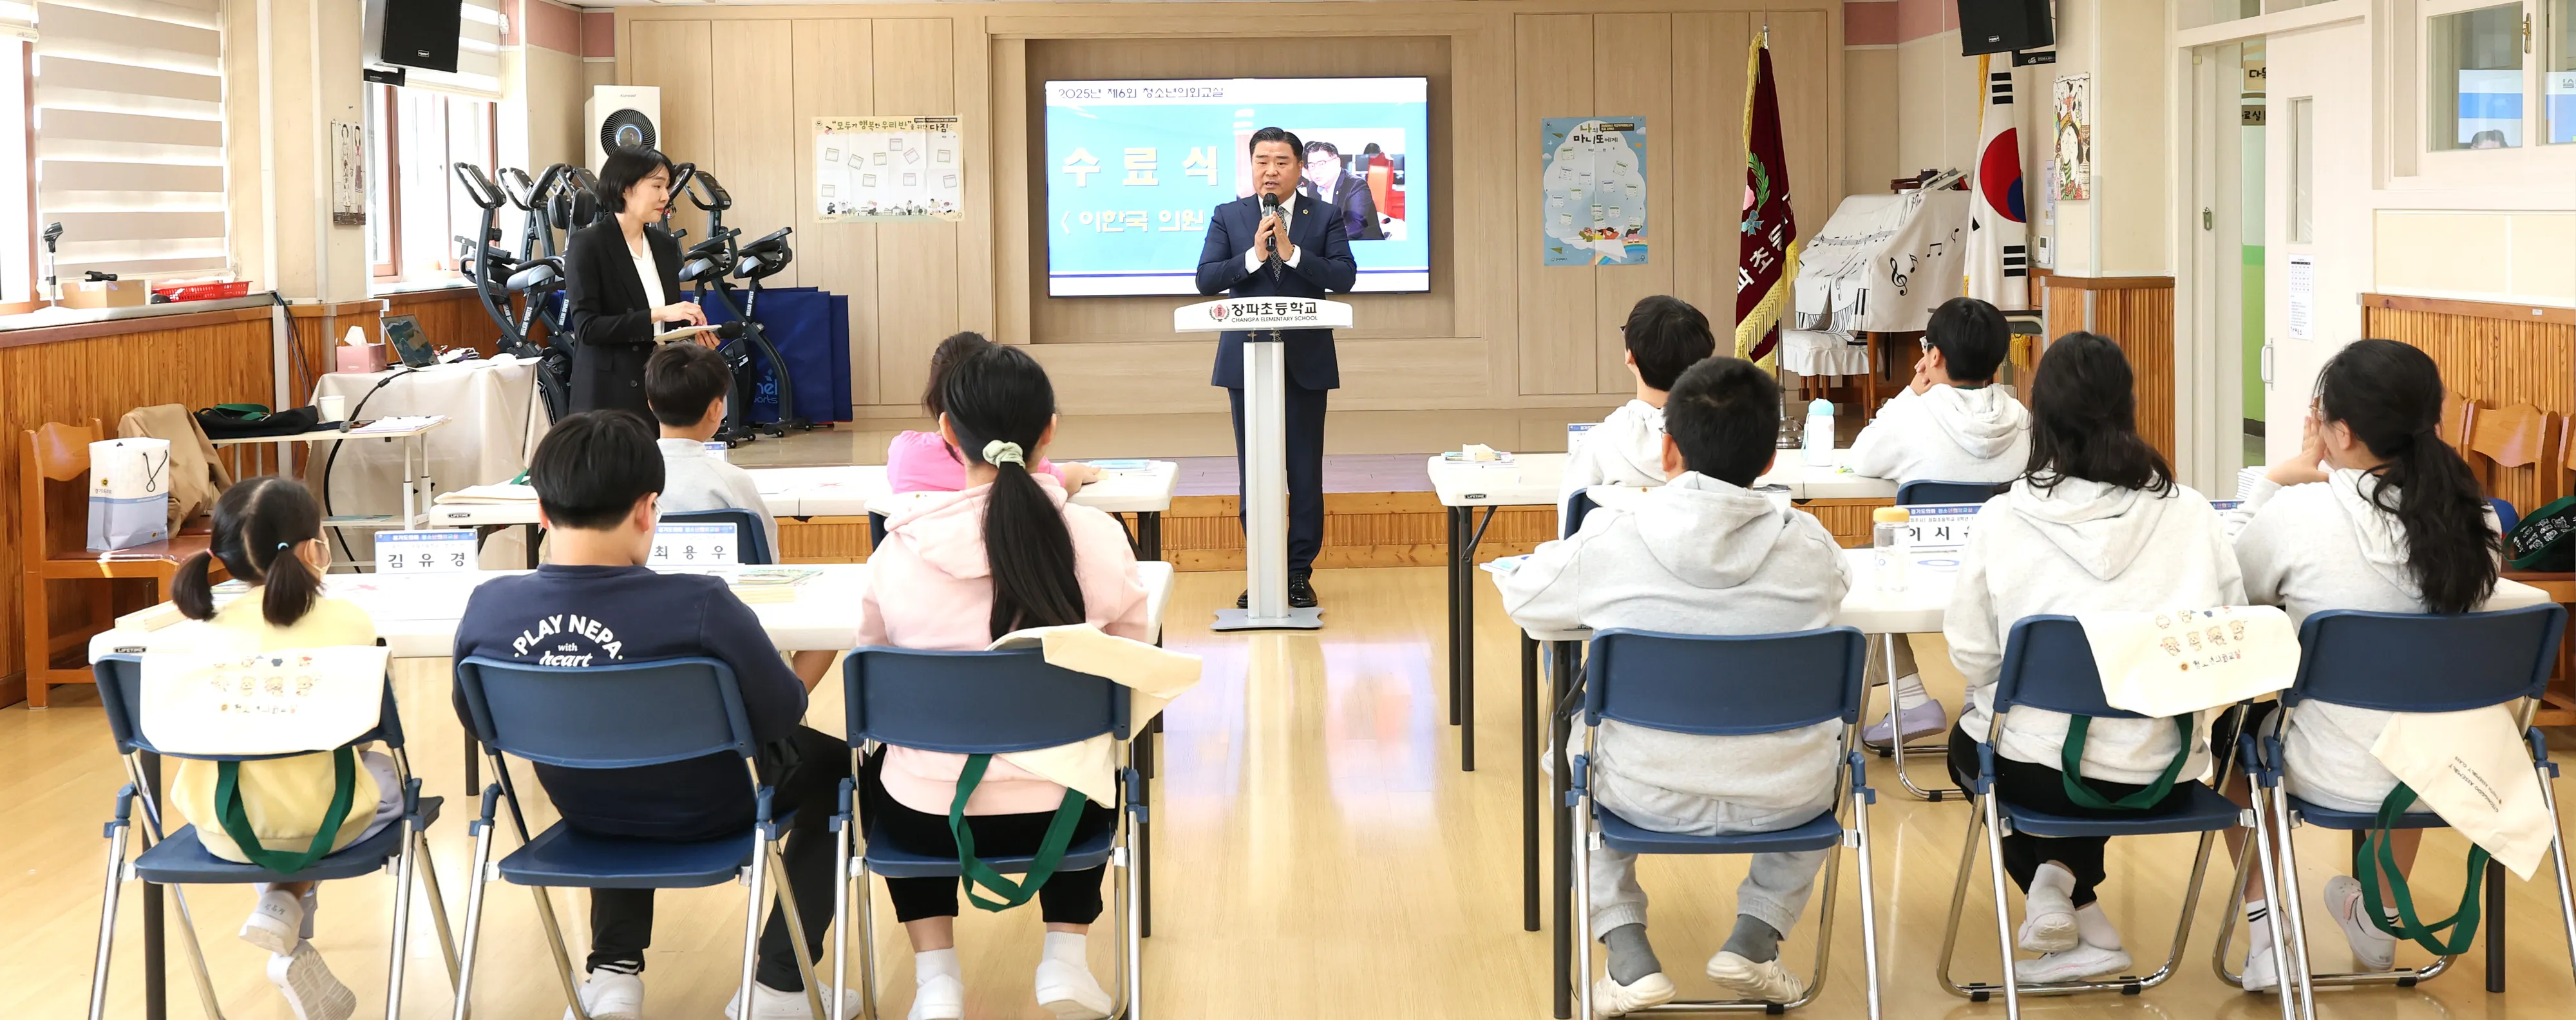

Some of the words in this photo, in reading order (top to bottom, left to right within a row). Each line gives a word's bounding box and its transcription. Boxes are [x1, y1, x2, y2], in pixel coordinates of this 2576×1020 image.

[1058, 88, 1101, 99] 2025년
[1107, 88, 1137, 99] 제6회
[1142, 87, 1223, 99] 청소년의회교실
[2242, 110, 2261, 121] 료실
[858, 120, 880, 131] 행복한
[882, 120, 896, 129] 우리
[929, 124, 949, 133] 다짐
[1580, 123, 1598, 133] 나의
[1573, 134, 1618, 144] 마니또에게
[1079, 209, 1148, 232] 이한국
[1158, 209, 1204, 232] 의원
[524, 306, 533, 321] SPORTS
[1231, 302, 1317, 317] 장파초등학교
[513, 614, 563, 656] PLAY
[568, 614, 622, 660] NEPA
[558, 642, 578, 652] with
[539, 650, 593, 667] heart
[2454, 756, 2467, 768] CLASS
[2448, 764, 2474, 786] ASSEMBLY
